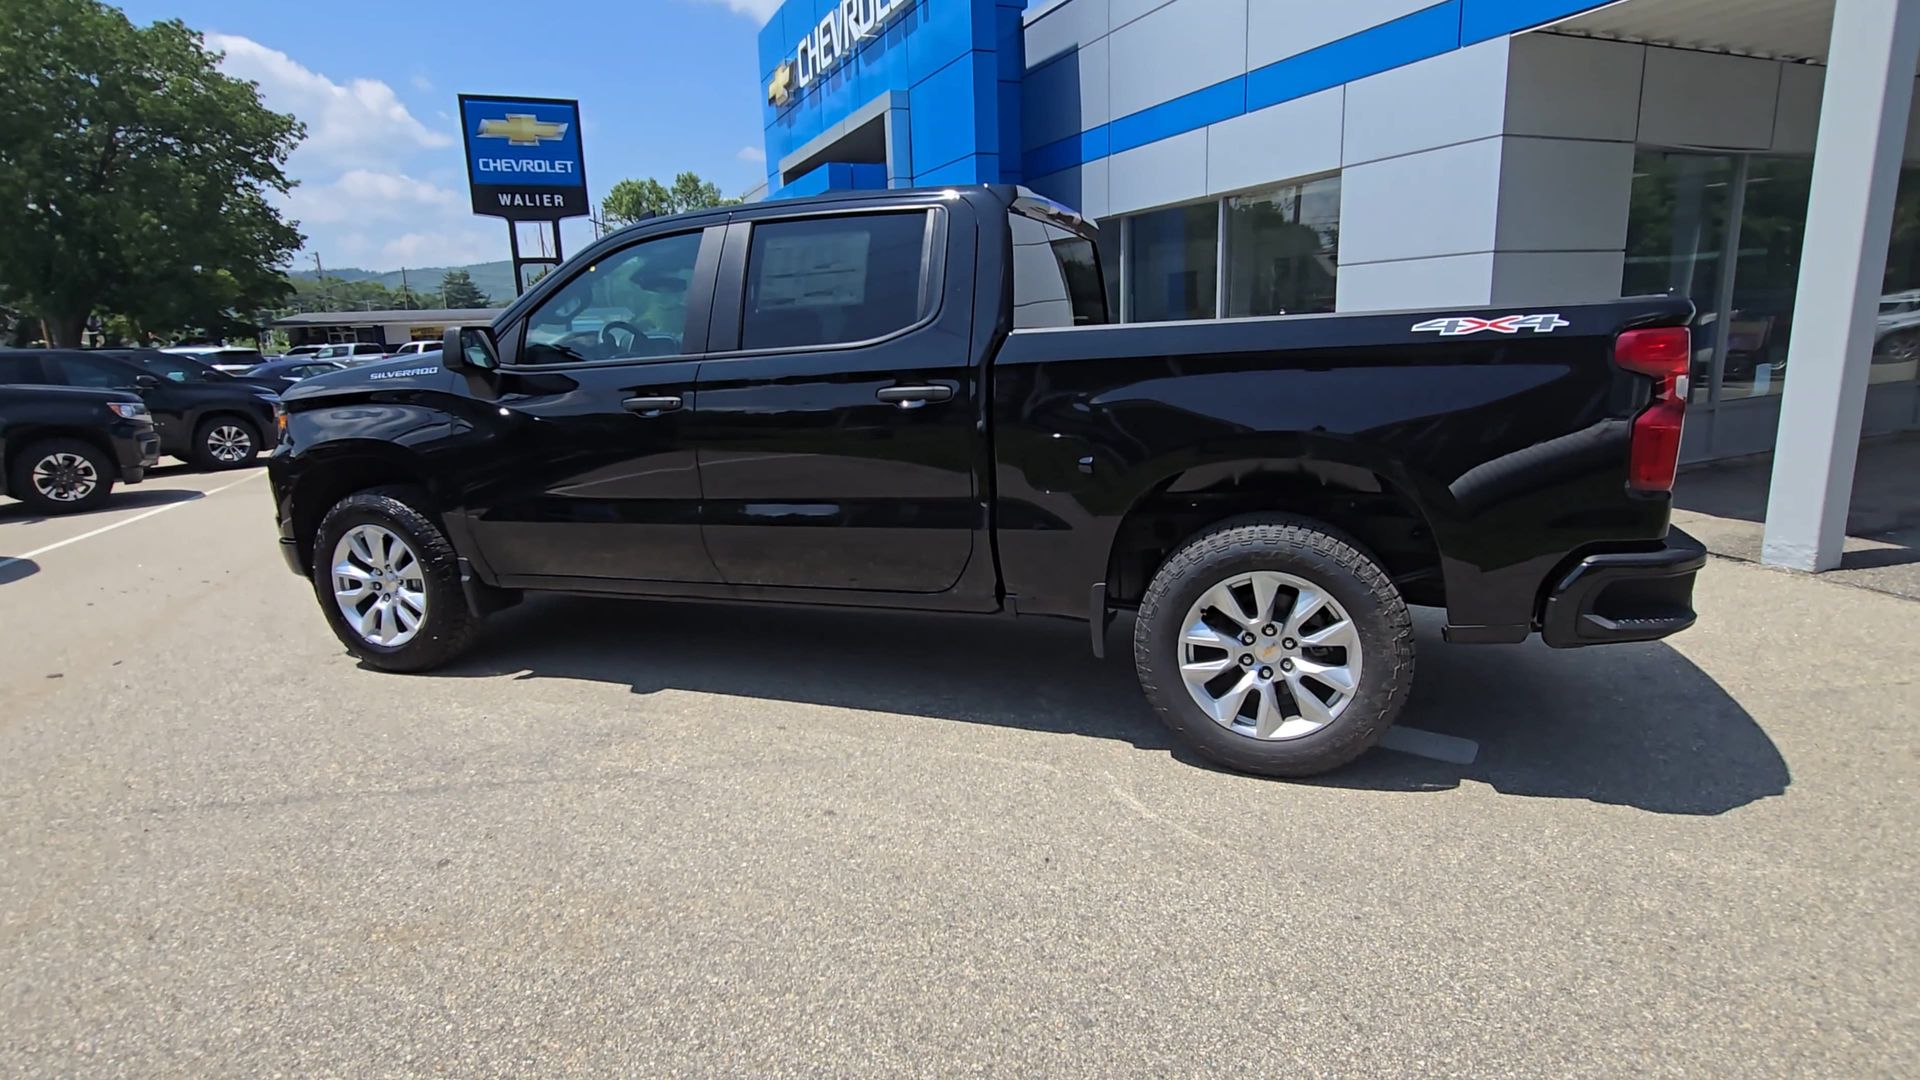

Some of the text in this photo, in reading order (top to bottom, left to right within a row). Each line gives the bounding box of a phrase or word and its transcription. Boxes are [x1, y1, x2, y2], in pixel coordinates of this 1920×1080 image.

[797, 0, 904, 88] CHEVROL
[478, 158, 574, 173] CHEVROLET
[498, 193, 564, 207] WALIER
[370, 366, 439, 380] SILVERADO
